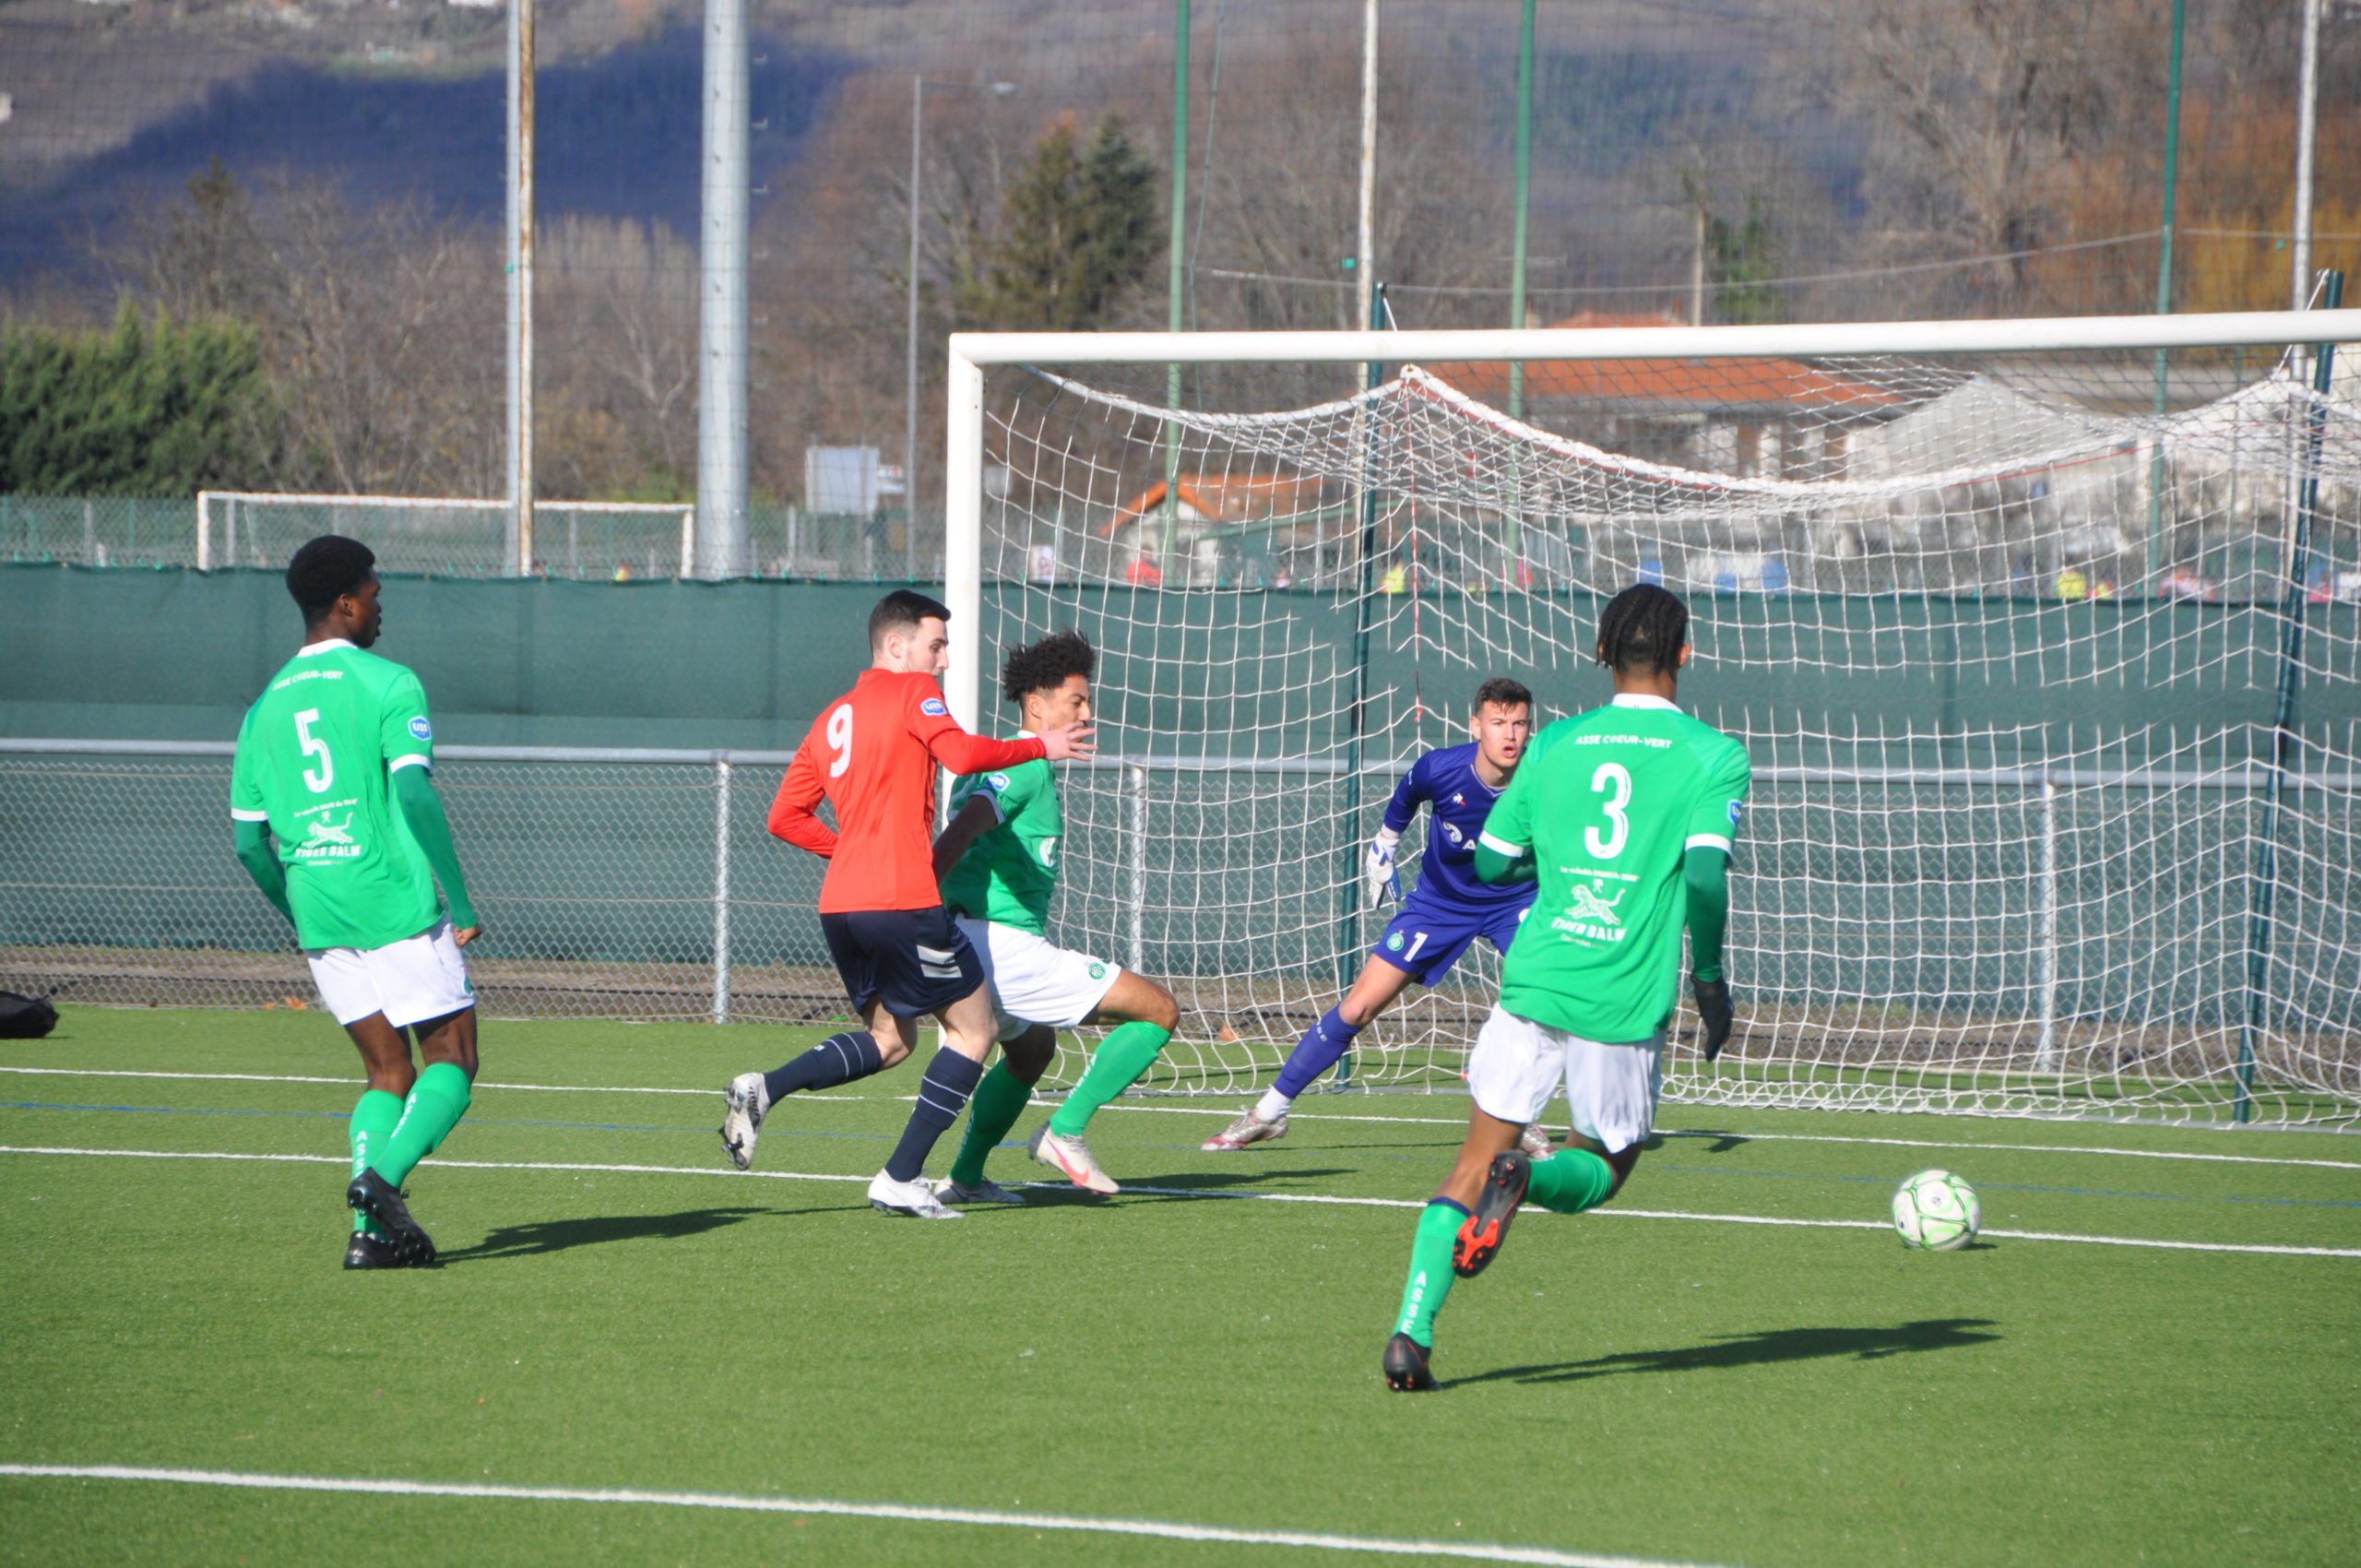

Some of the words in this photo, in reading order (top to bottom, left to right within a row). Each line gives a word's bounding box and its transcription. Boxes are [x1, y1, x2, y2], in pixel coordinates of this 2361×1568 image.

[293, 707, 333, 793] 5
[826, 703, 853, 778] 9
[1575, 734, 1601, 745] ASSE
[1584, 762, 1632, 860] 3
[1404, 932, 1429, 963] 1
[1400, 1270, 1427, 1336] ASSE
